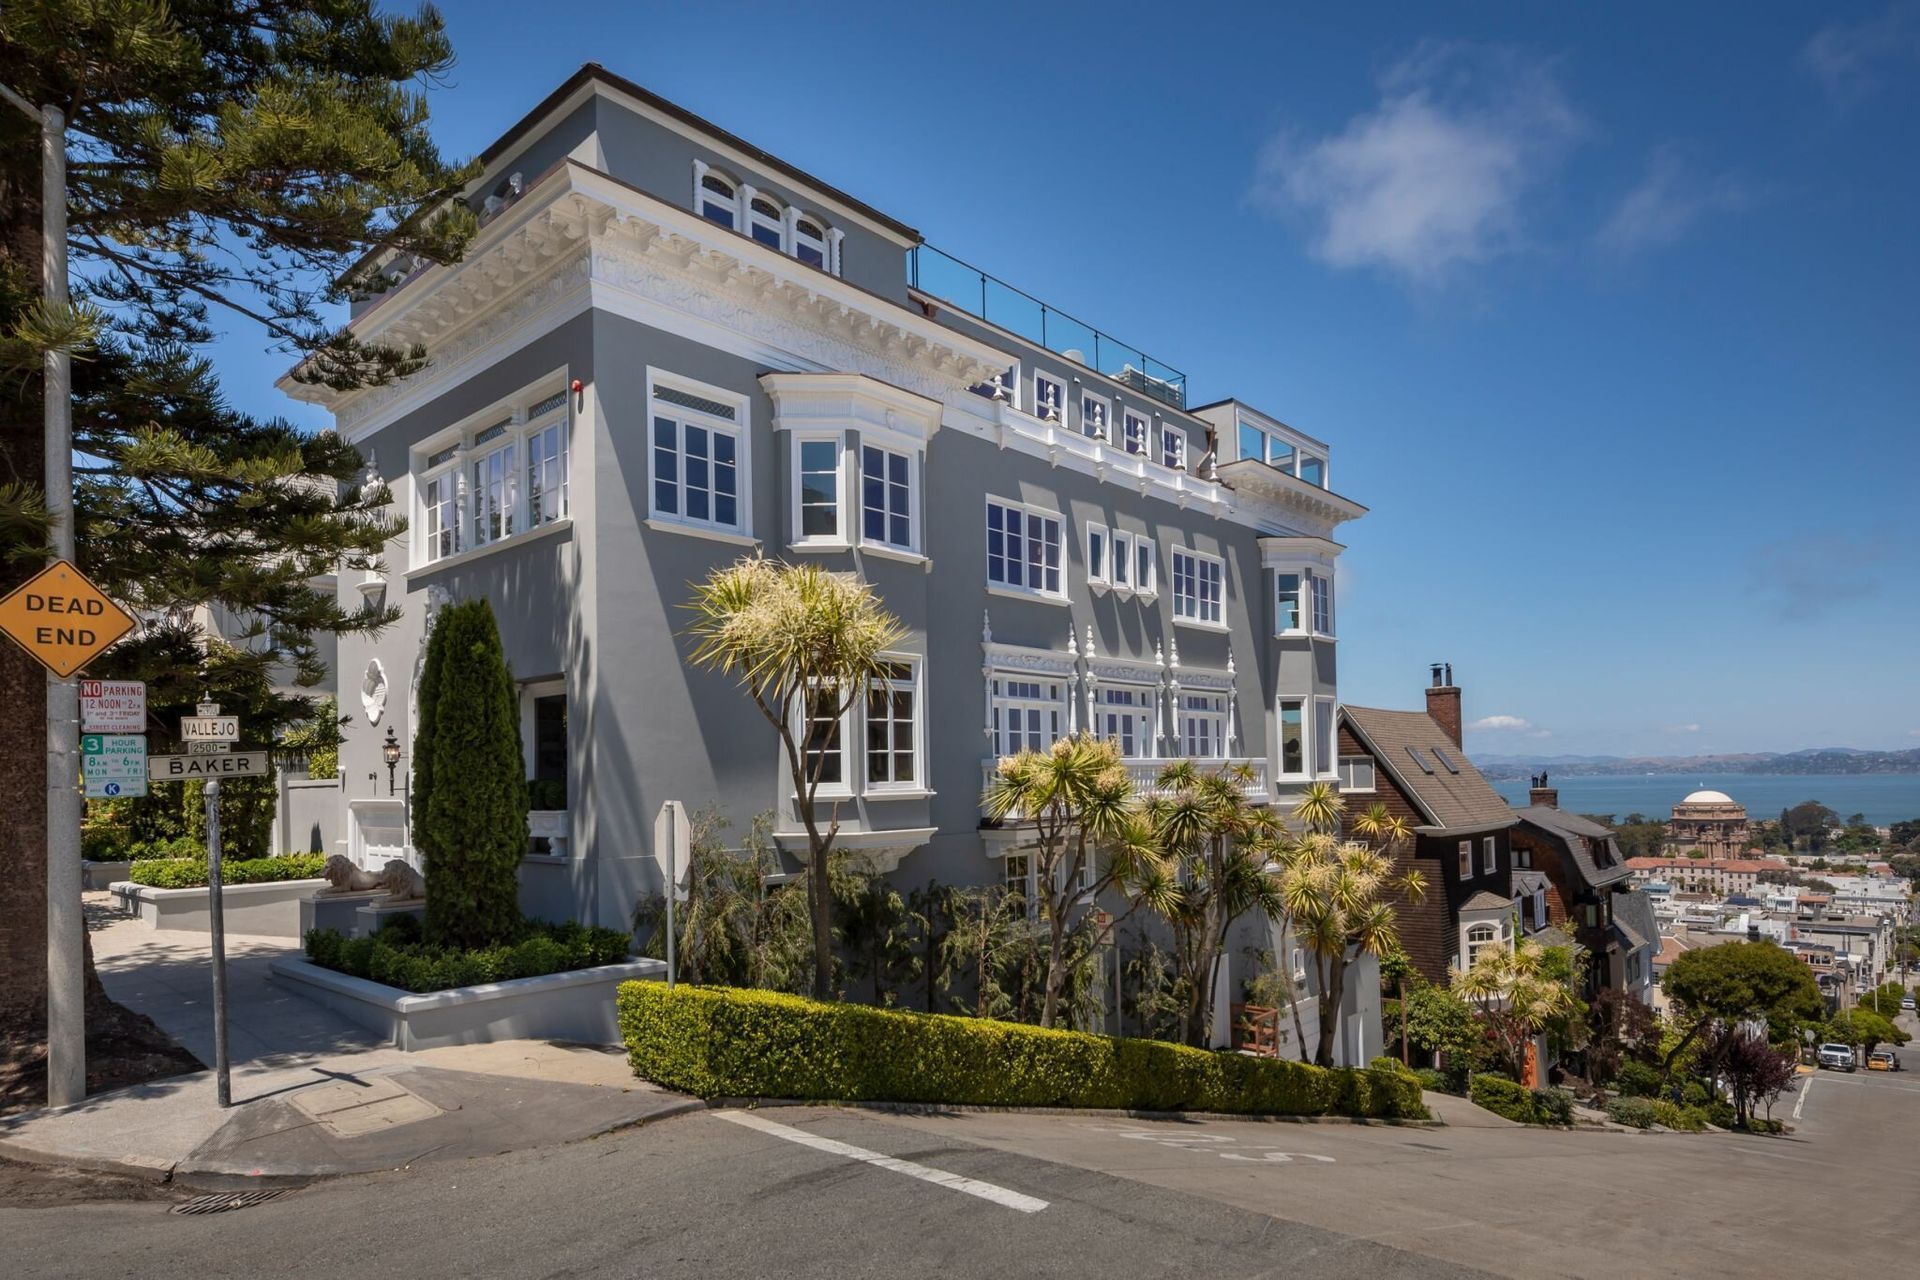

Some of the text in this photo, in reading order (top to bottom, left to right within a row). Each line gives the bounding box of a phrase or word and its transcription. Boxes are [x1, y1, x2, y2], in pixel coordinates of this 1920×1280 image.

[26, 594, 104, 616] DEAD
[36, 627, 96, 646] END
[84, 682, 143, 696] NO PARKING
[86, 699, 95, 709] 12
[98, 699, 121, 709] NOON
[184, 722, 235, 736] VALLEJO
[87, 738, 100, 751] 3
[193, 744, 217, 752] 2500
[169, 758, 250, 775] BAKER
